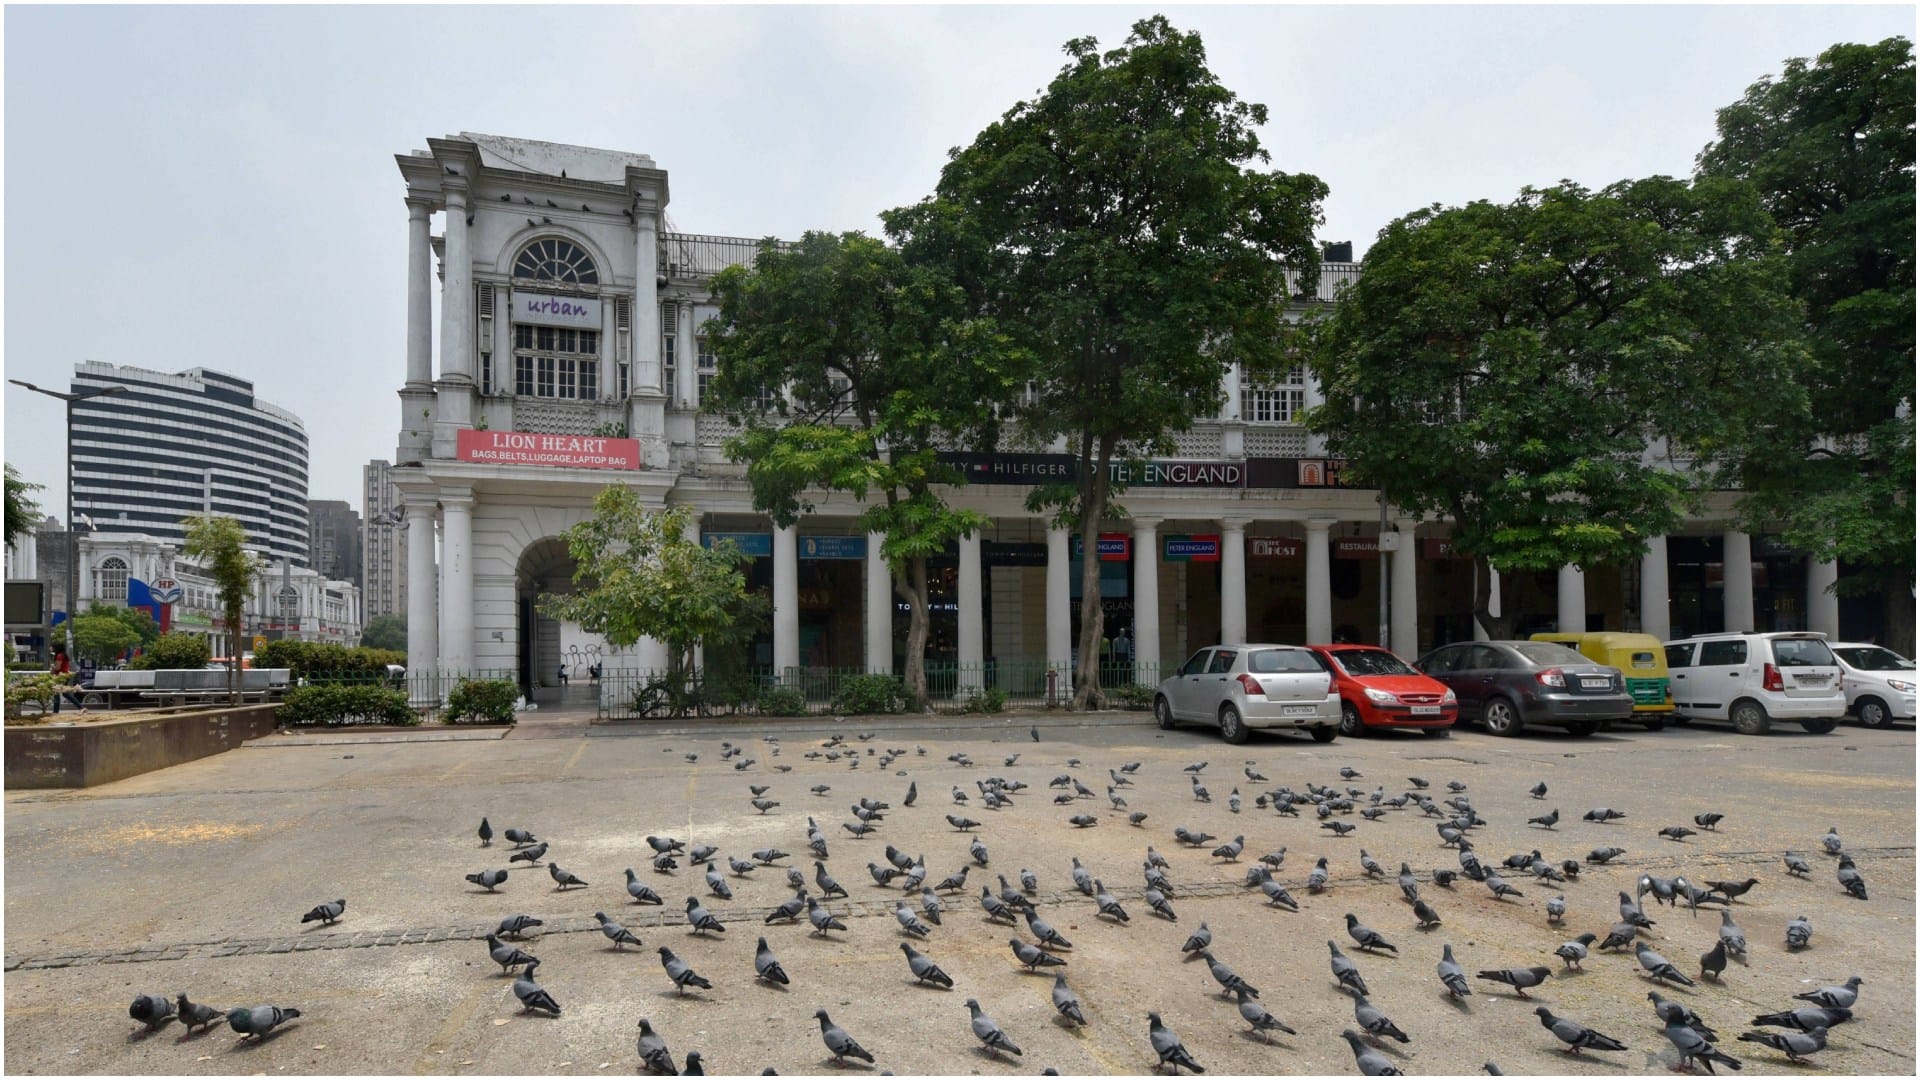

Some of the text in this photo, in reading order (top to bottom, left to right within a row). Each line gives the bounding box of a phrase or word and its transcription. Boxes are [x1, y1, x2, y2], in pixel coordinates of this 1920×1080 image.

[528, 297, 587, 316] urban
[493, 433, 607, 453] LION HEART
[609, 456, 627, 465] BAG
[994, 463, 1067, 475] HILFIGER
[1144, 464, 1240, 483] ENGLAND
[1339, 543, 1378, 551] RESTAURA
[158, 580, 175, 589] HP
